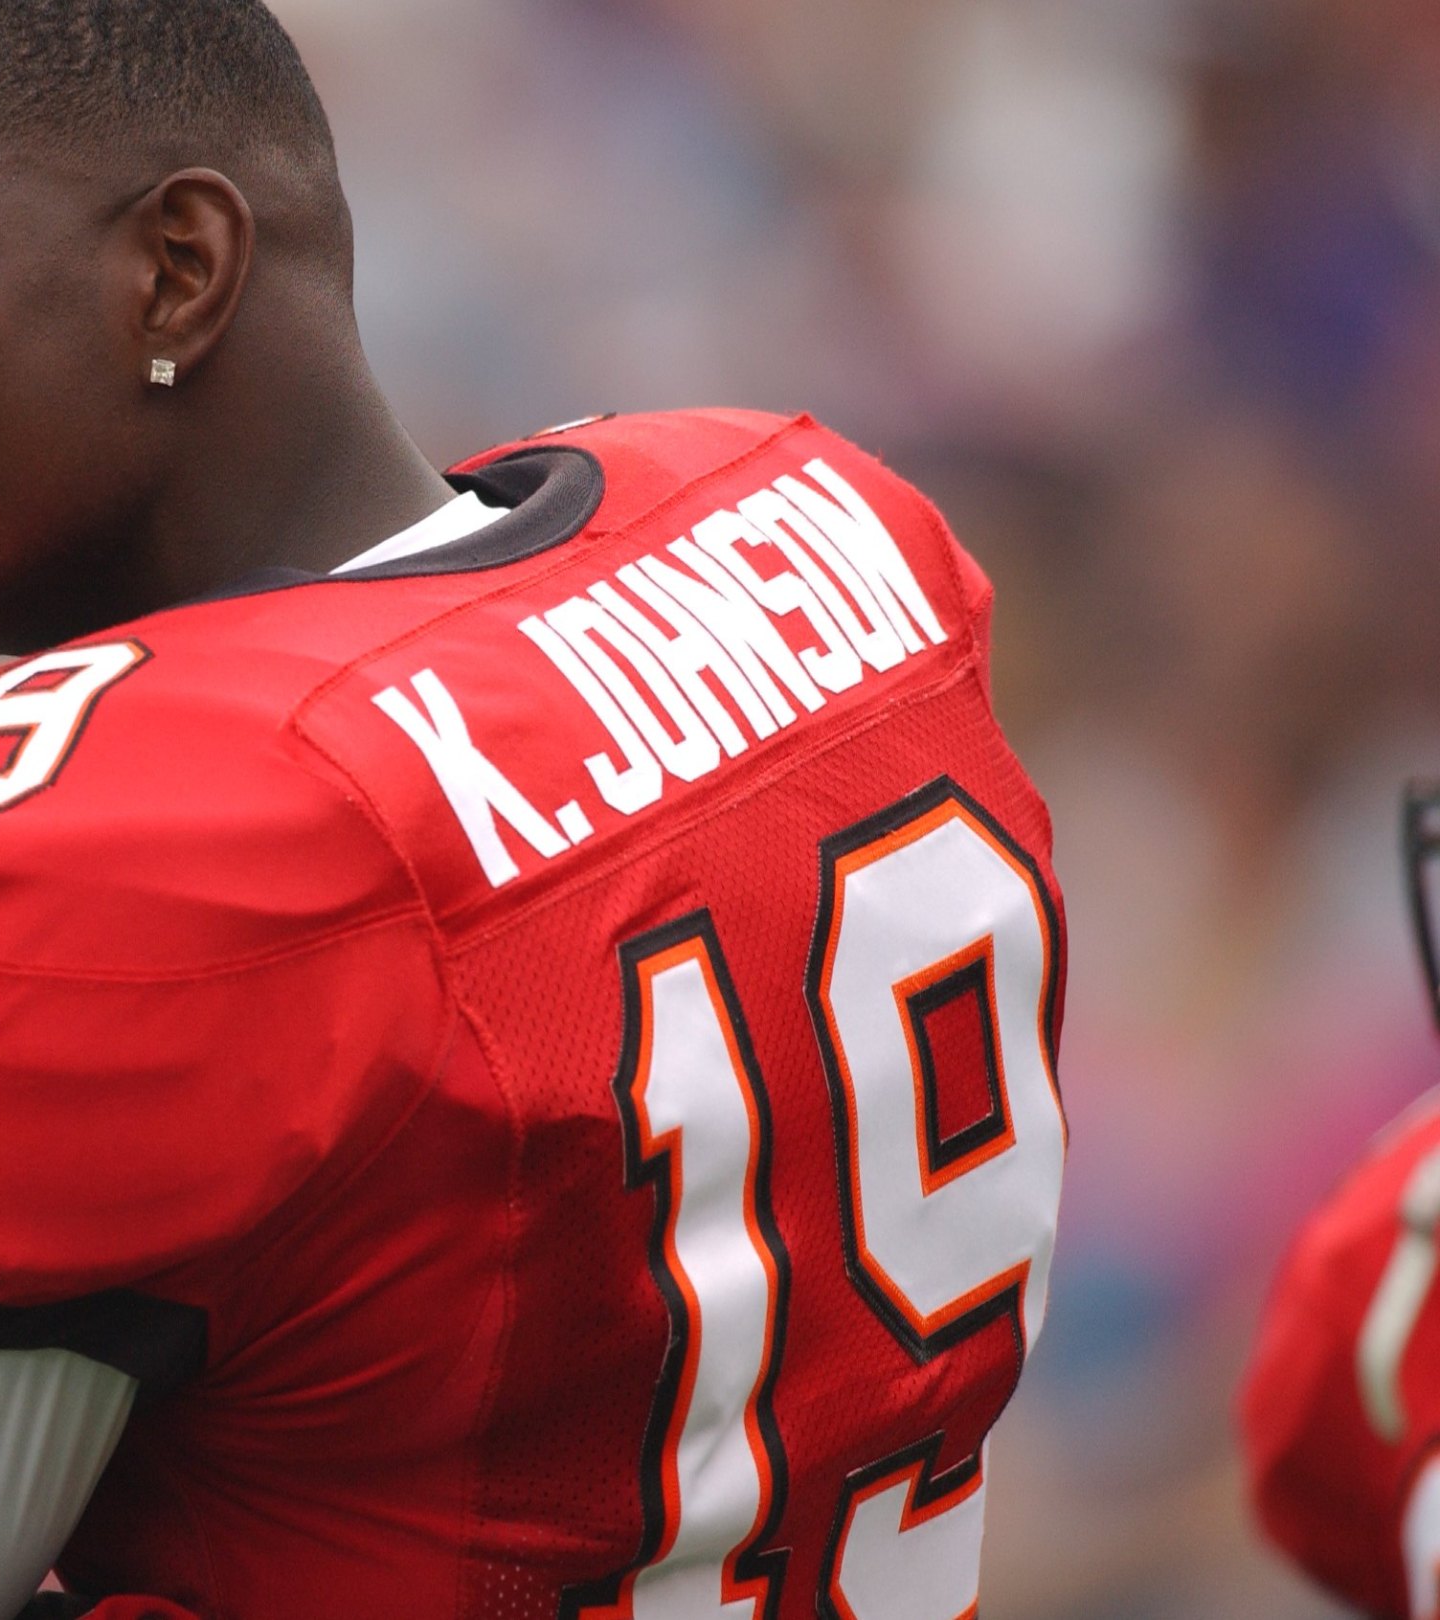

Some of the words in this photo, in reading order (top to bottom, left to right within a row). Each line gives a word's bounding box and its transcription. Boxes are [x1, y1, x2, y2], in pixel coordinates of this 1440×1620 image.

[370, 668, 594, 888] K.
[517, 458, 948, 815] JOHNSON
[556, 774, 1069, 1620] 19
